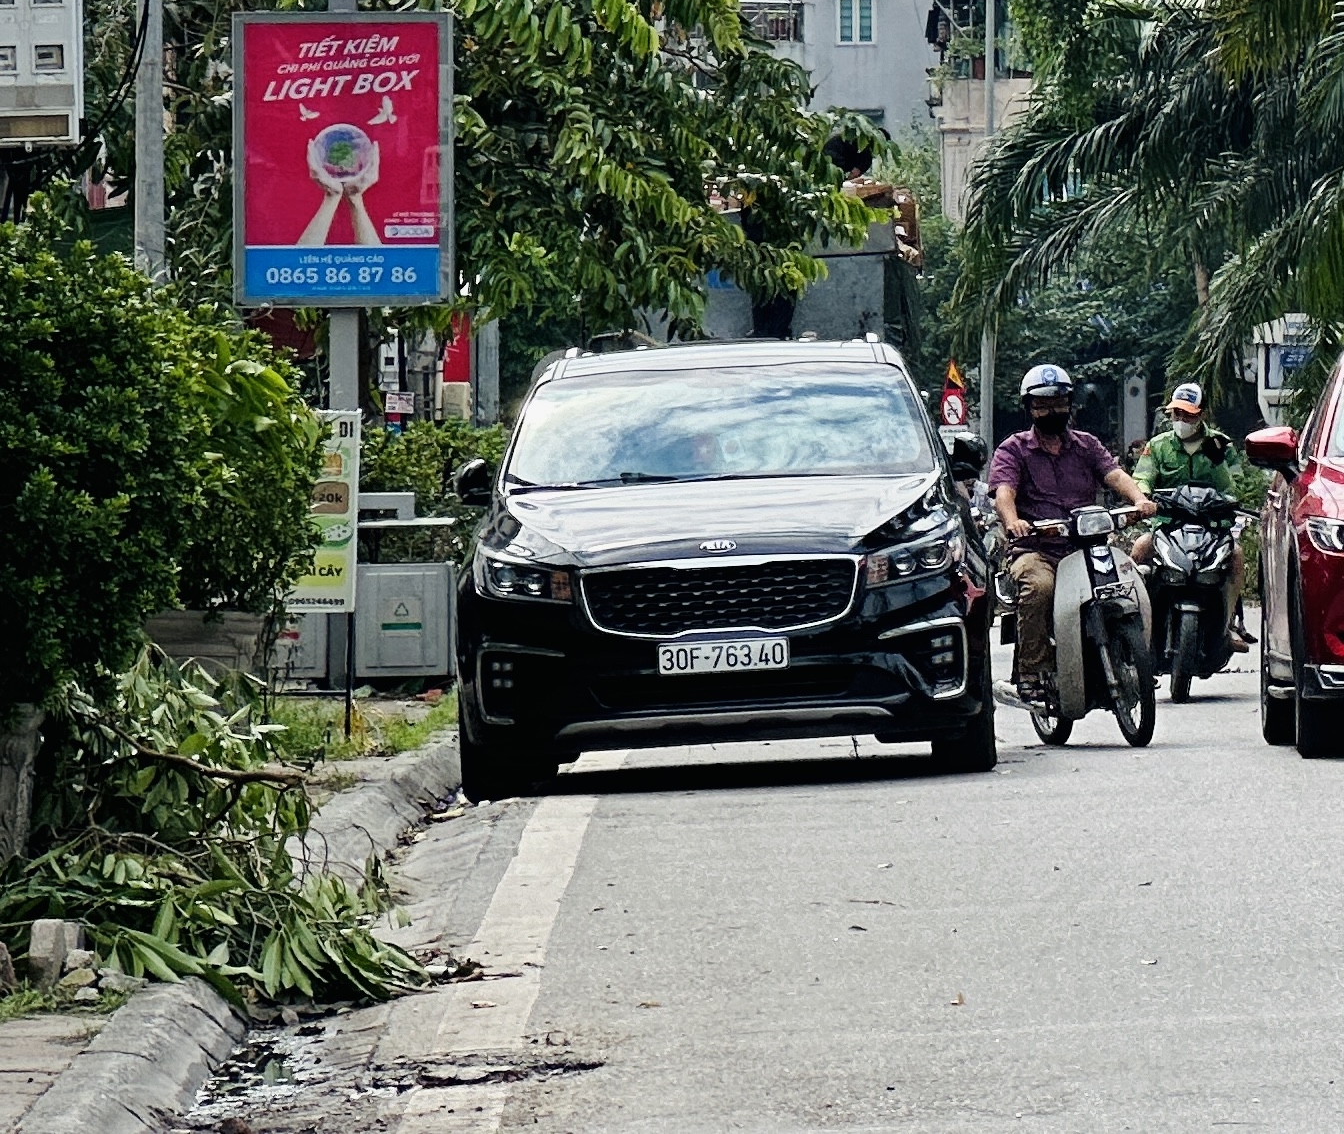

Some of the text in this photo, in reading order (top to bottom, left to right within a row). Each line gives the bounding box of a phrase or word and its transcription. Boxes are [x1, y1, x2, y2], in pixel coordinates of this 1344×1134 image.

[299, 34, 400, 59] TIẾT KIỆM
[277, 64, 298, 74] CHI
[300, 60, 321, 73] PHÍ
[323, 57, 368, 71] QUẢNG
[370, 55, 396, 67] CÁO
[263, 70, 419, 102] LIGHT BOX
[266, 266, 417, 284] 0865 86 87 86
[319, 564, 343, 577] CÂY
[661, 642, 785, 671] 30F-763.40
